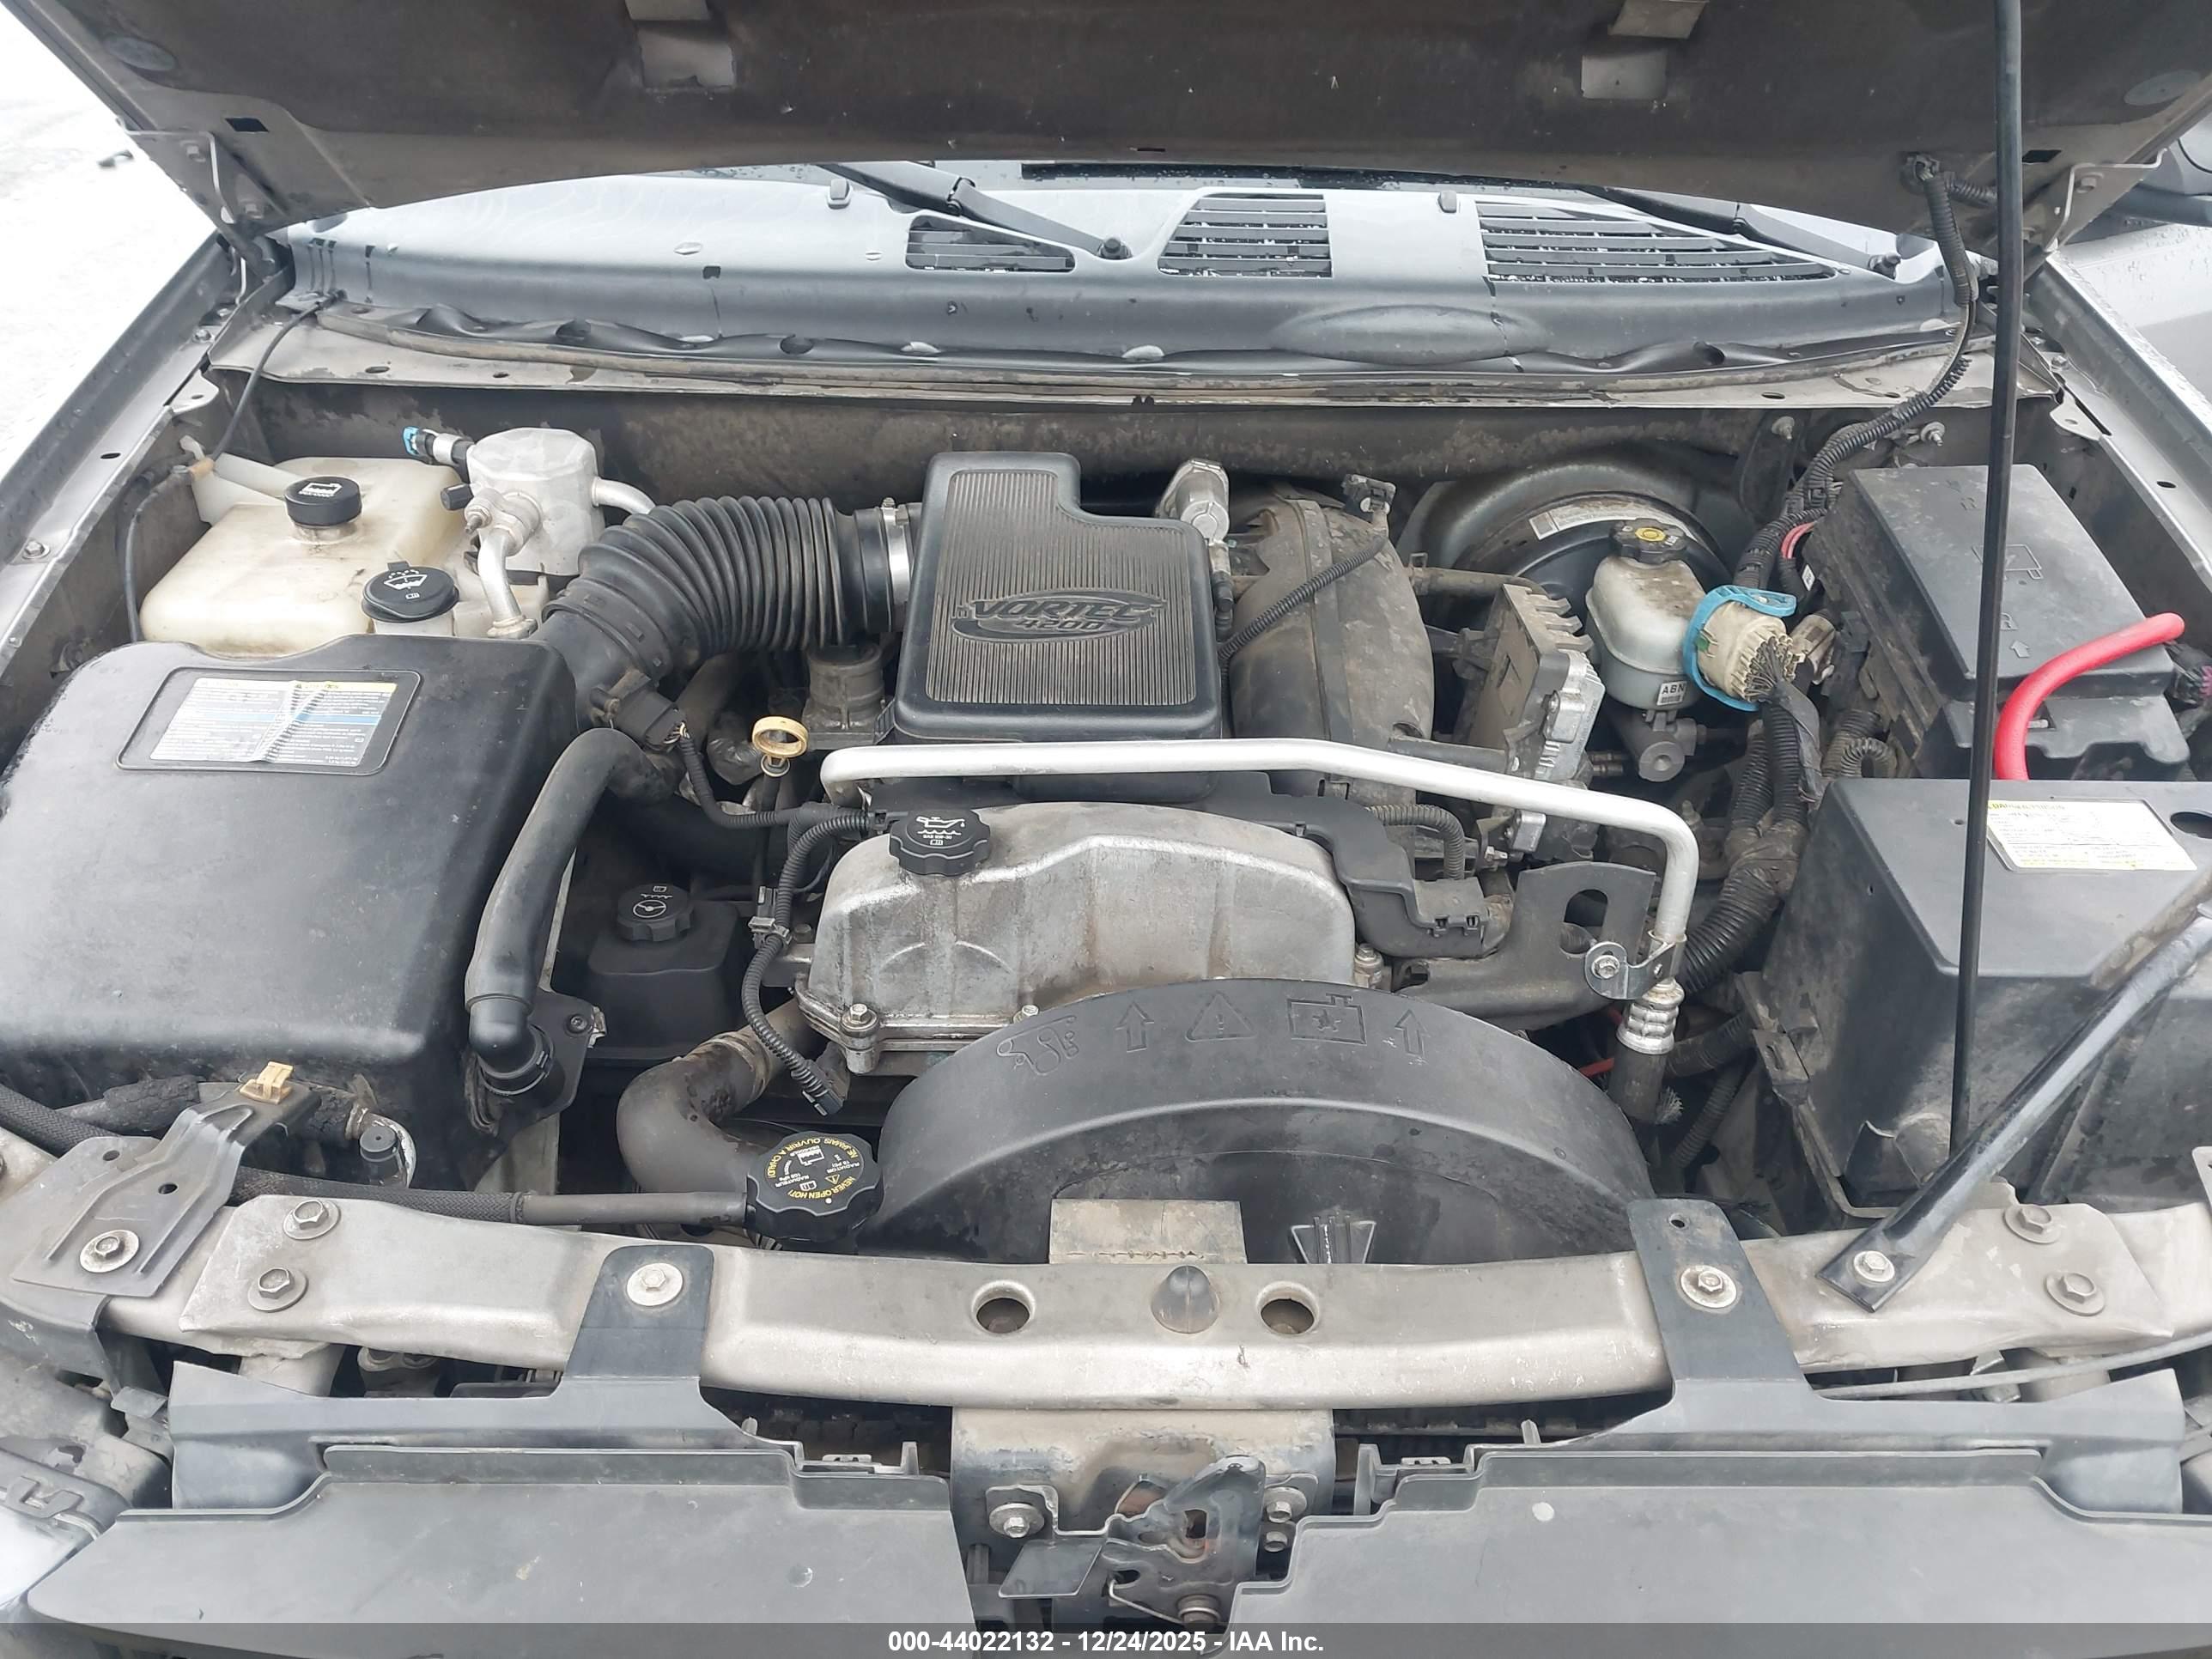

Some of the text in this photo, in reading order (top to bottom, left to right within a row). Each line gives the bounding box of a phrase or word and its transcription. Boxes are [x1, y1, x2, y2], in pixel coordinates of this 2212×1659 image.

[972, 599, 1152, 622] VORTEC
[1016, 619, 1105, 632] 4200
[1661, 683, 1686, 695] ABN
[785, 1138, 821, 1152] OUVRIR
[823, 1138, 850, 1152] JAMAIS
[848, 1148, 859, 1158] NE
[767, 1155, 781, 1178] CHAUD!
[826, 1161, 860, 1174] RADIATOR
[787, 1176, 856, 1199] NEVER OPEN HOT!
